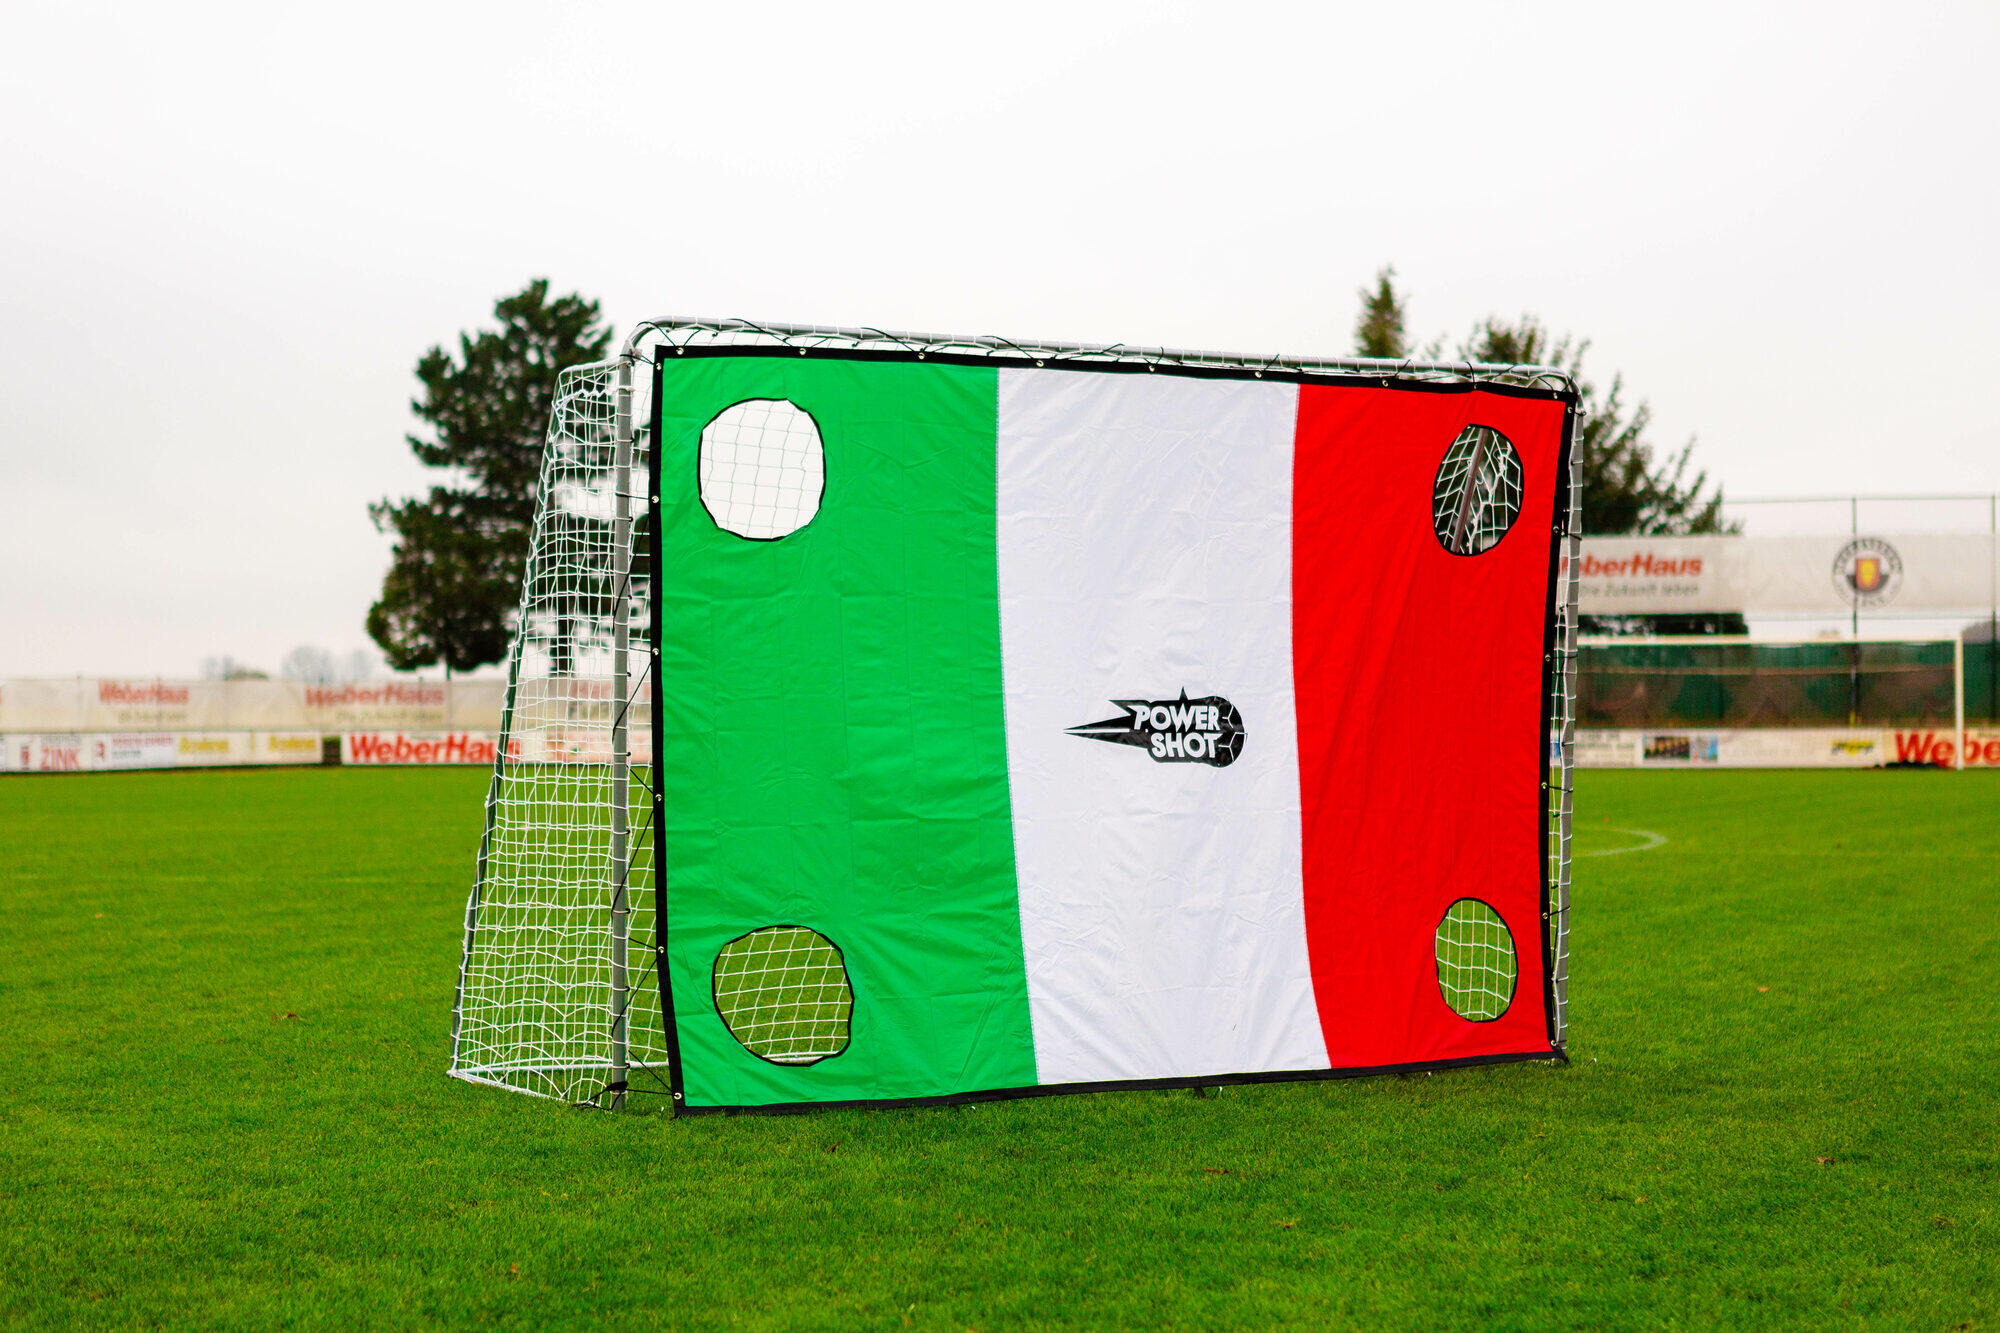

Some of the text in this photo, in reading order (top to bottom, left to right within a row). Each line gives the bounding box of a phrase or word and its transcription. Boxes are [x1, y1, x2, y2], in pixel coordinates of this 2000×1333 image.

[1127, 703, 1220, 732] POWER
[1150, 732, 1223, 758] SHOT
[41, 747, 80, 771] ZINK
